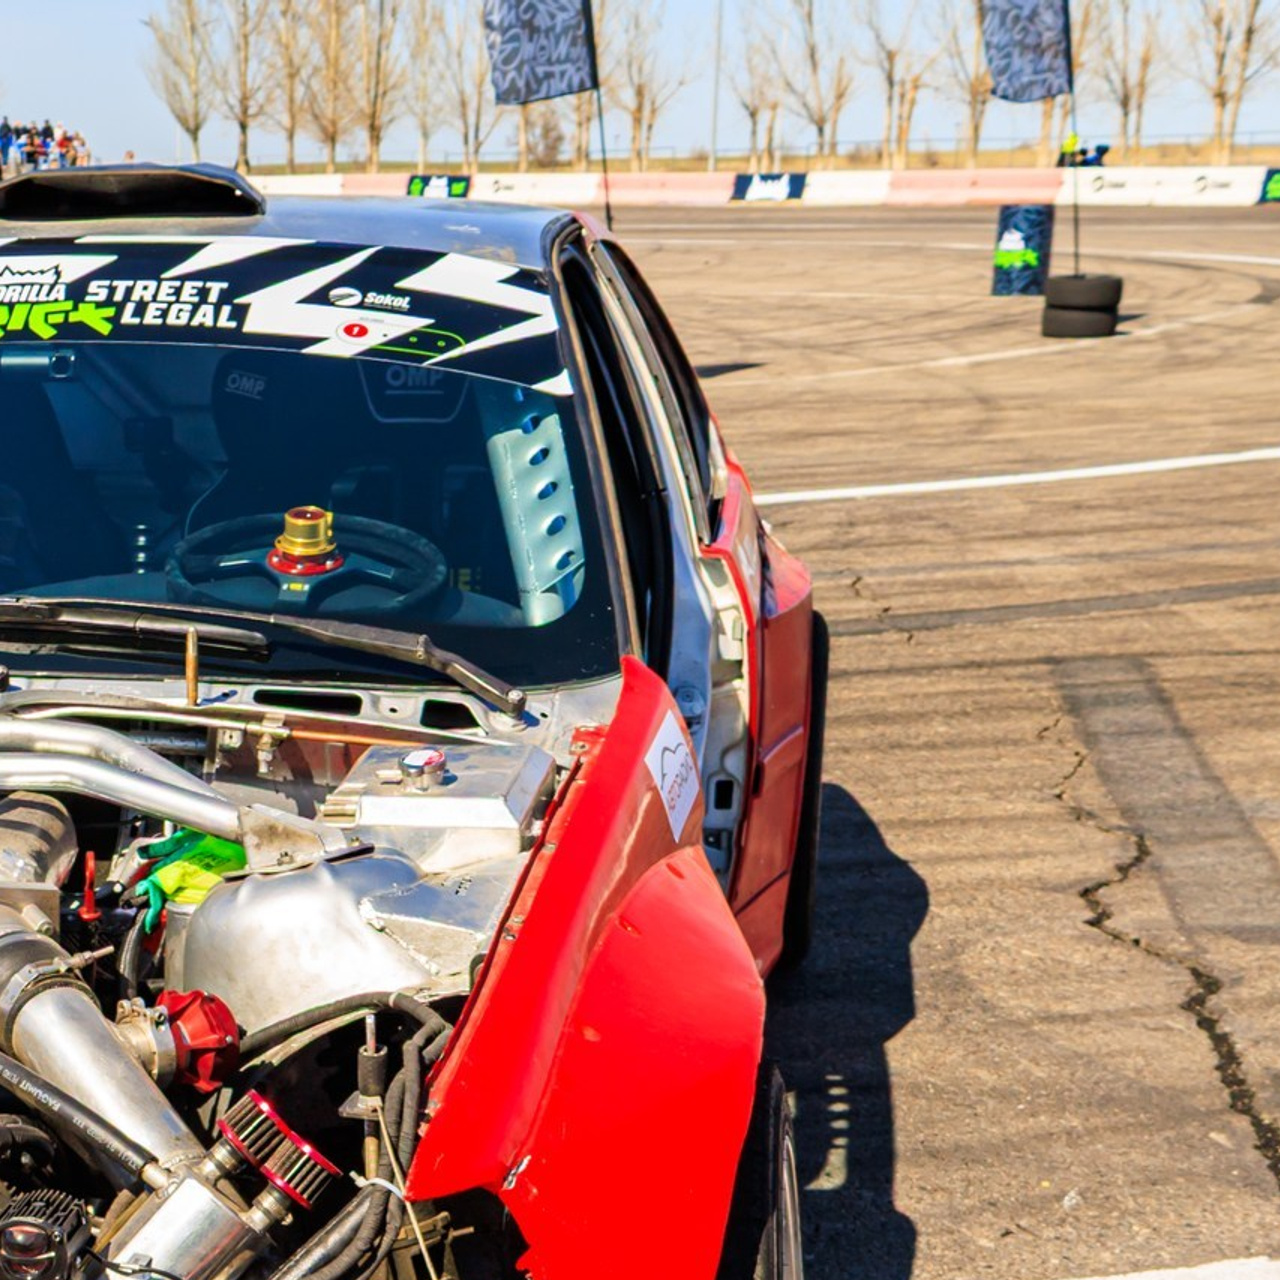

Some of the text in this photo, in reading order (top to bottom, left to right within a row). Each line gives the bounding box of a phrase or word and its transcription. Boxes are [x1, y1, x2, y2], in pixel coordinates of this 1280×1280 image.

[84, 280, 228, 303] STREET
[120, 303, 237, 328] LEGAL
[227, 372, 266, 395] OMP
[385, 364, 444, 387] OMP
